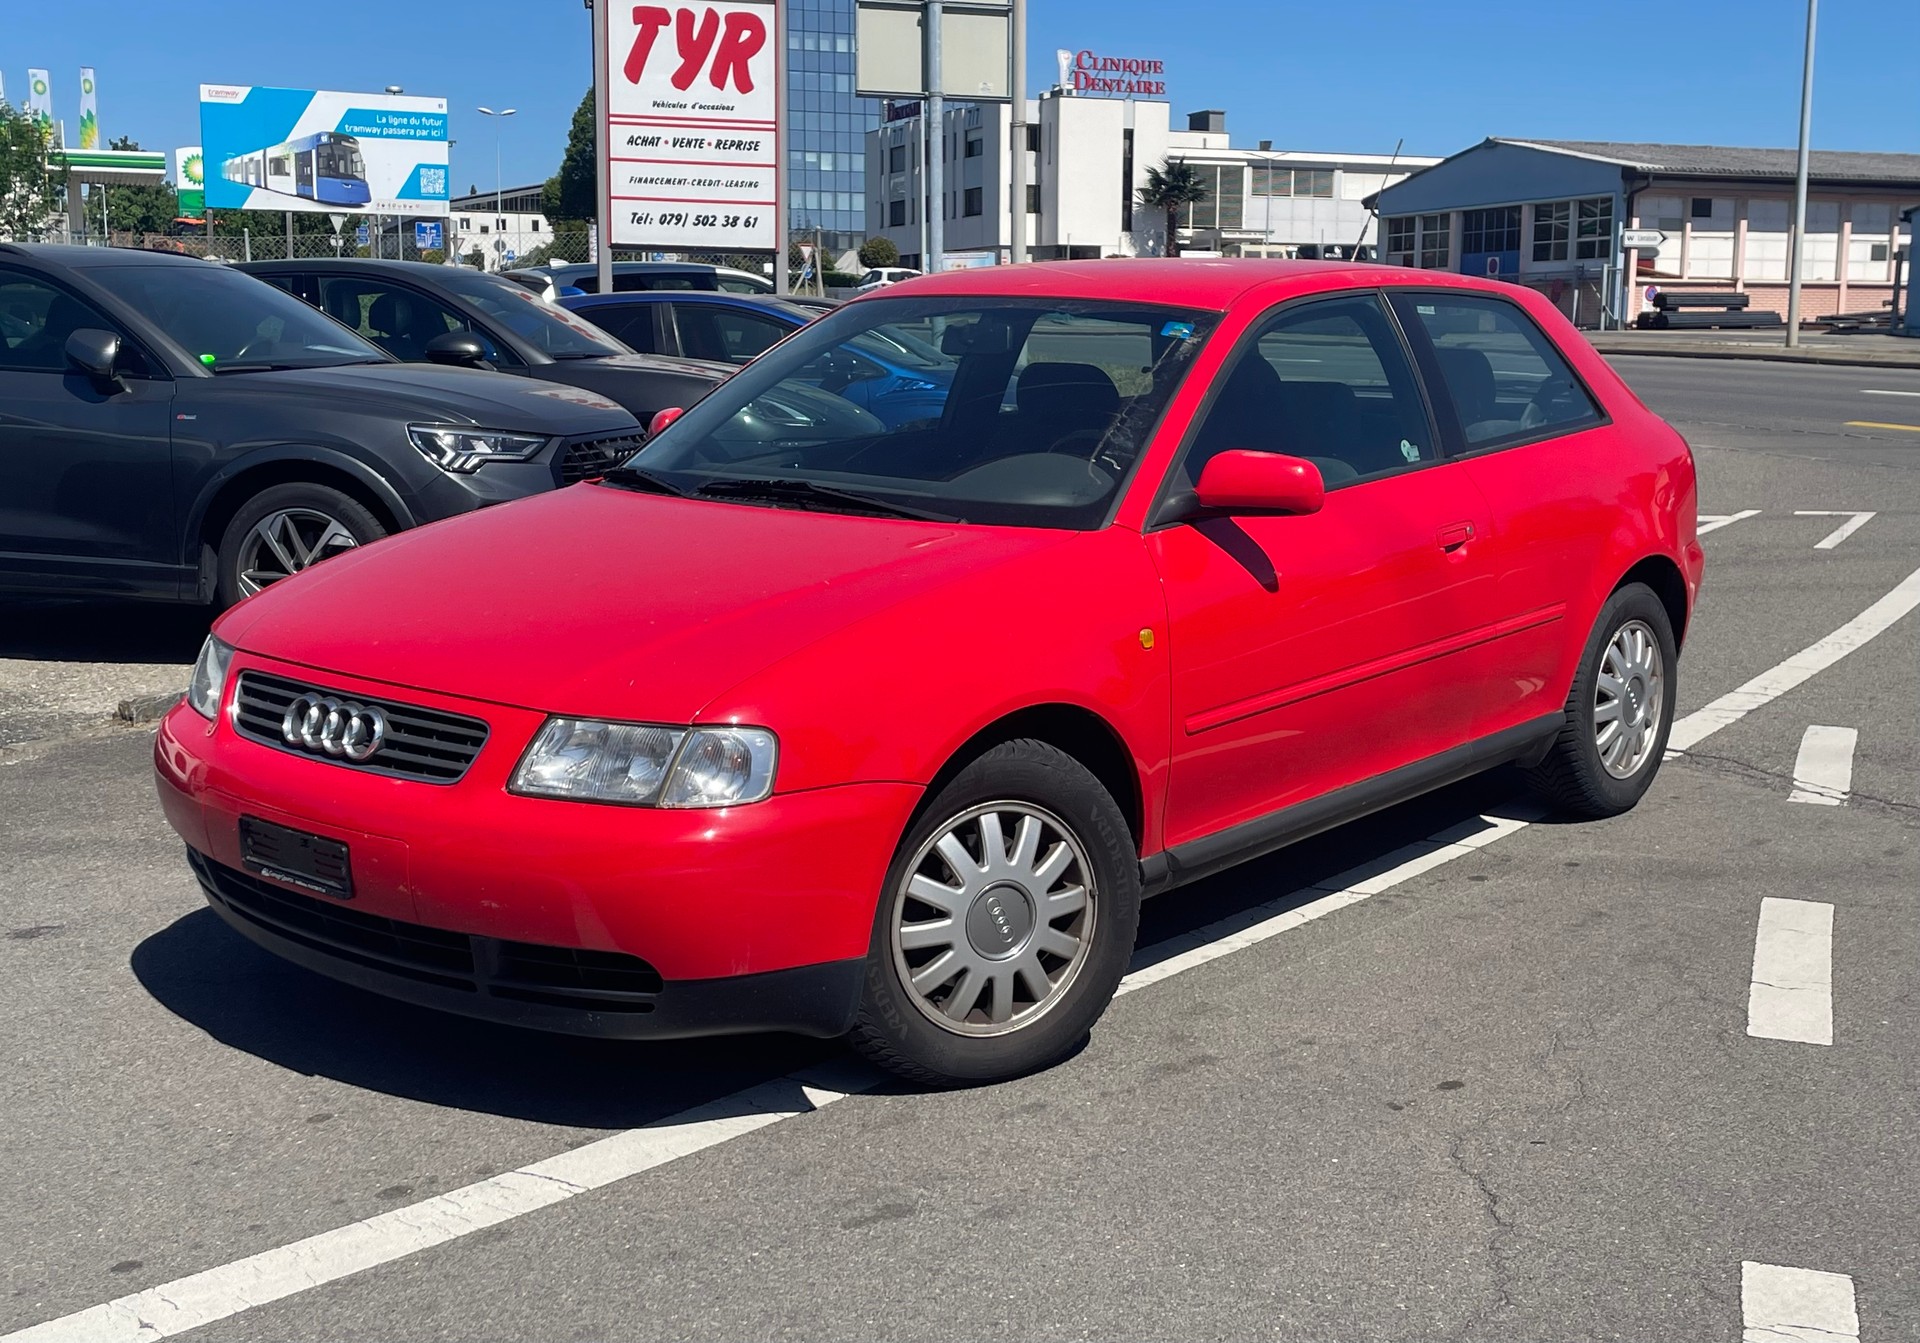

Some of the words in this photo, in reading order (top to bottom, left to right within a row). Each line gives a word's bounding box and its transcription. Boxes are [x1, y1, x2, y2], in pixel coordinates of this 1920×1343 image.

[623, 6, 767, 95] TYR
[1075, 50, 1164, 76] CLINIQUE
[1072, 70, 1166, 94] DENTAIRE
[652, 100, 688, 110] Véhicules
[690, 101, 736, 112] d'occasions
[376, 114, 387, 124] La
[388, 115, 408, 126] ligne
[409, 116, 420, 125] du
[421, 116, 443, 126] futur
[344, 124, 381, 135] tramway
[382, 127, 415, 136] passera
[415, 128, 430, 137] par
[626, 134, 662, 148] ACHAT
[671, 137, 706, 149] VENTE
[714, 139, 761, 151] REPRISE
[630, 212, 653, 225] Tél:
[692, 214, 717, 227] 502
[721, 215, 740, 228] 38
[743, 216, 759, 228] 61
